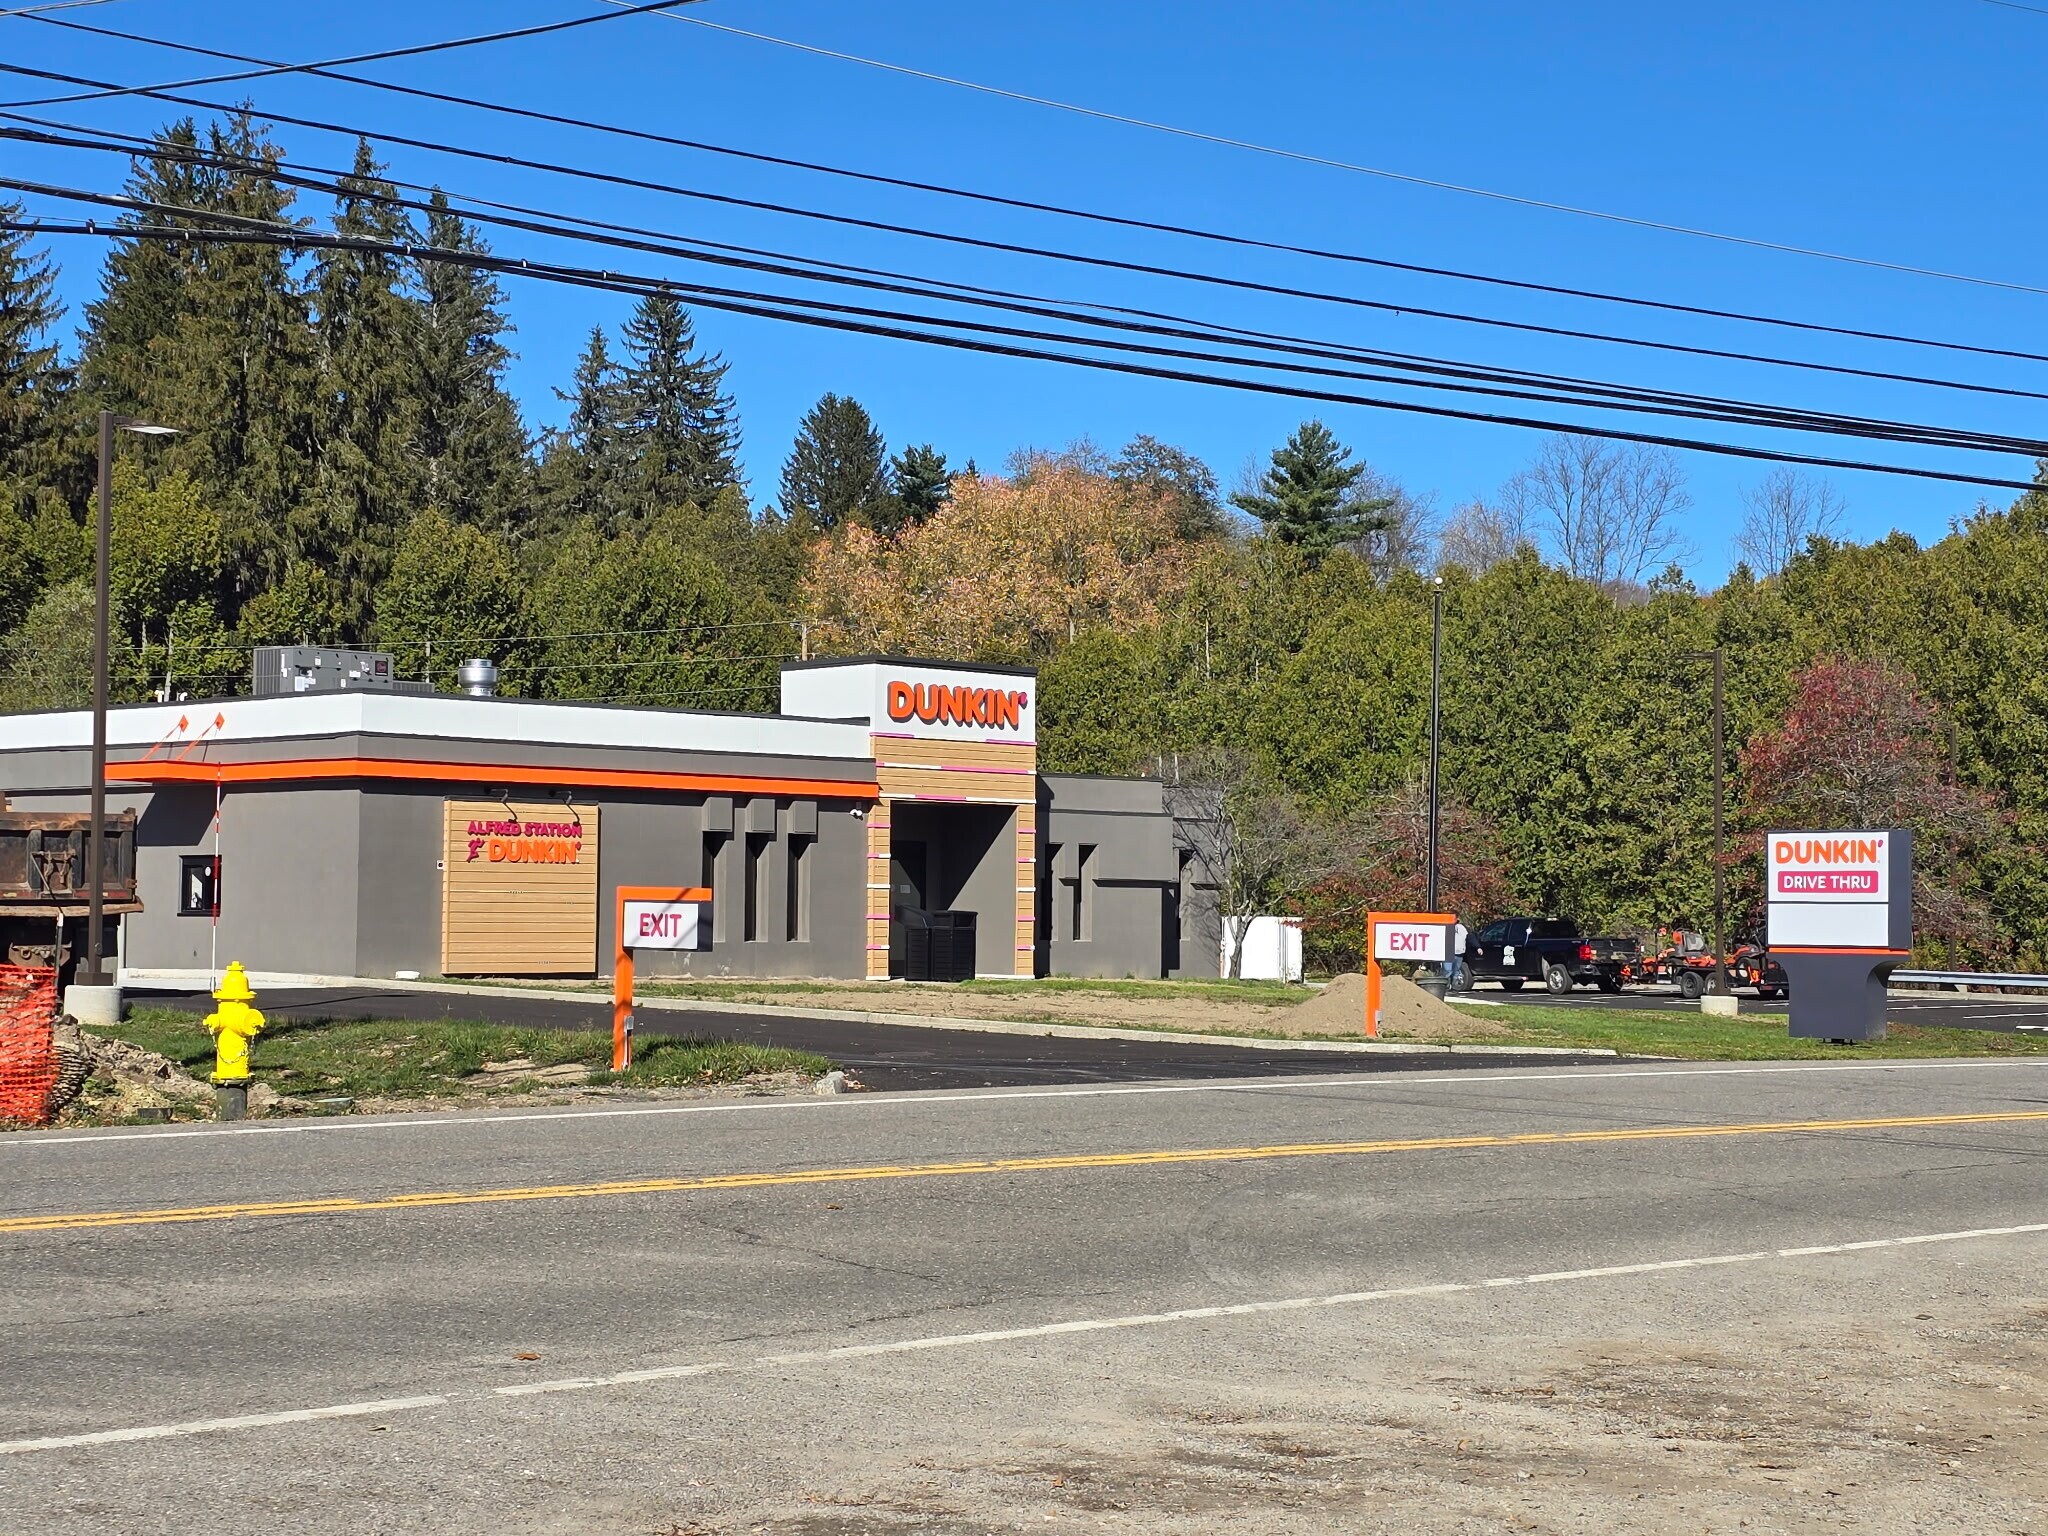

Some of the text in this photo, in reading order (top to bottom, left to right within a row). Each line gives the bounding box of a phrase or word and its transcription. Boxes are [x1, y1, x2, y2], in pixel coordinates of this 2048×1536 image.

[888, 681, 1027, 731] DUNKIN'
[468, 820, 582, 838] ALFRED STATION
[488, 838, 582, 864] DUNKIN'
[1775, 839, 1884, 864] DUNKIN'
[1783, 875, 1871, 889] DRIVE THRU
[639, 912, 682, 938] EXIT
[1390, 932, 1430, 952] EXIT
